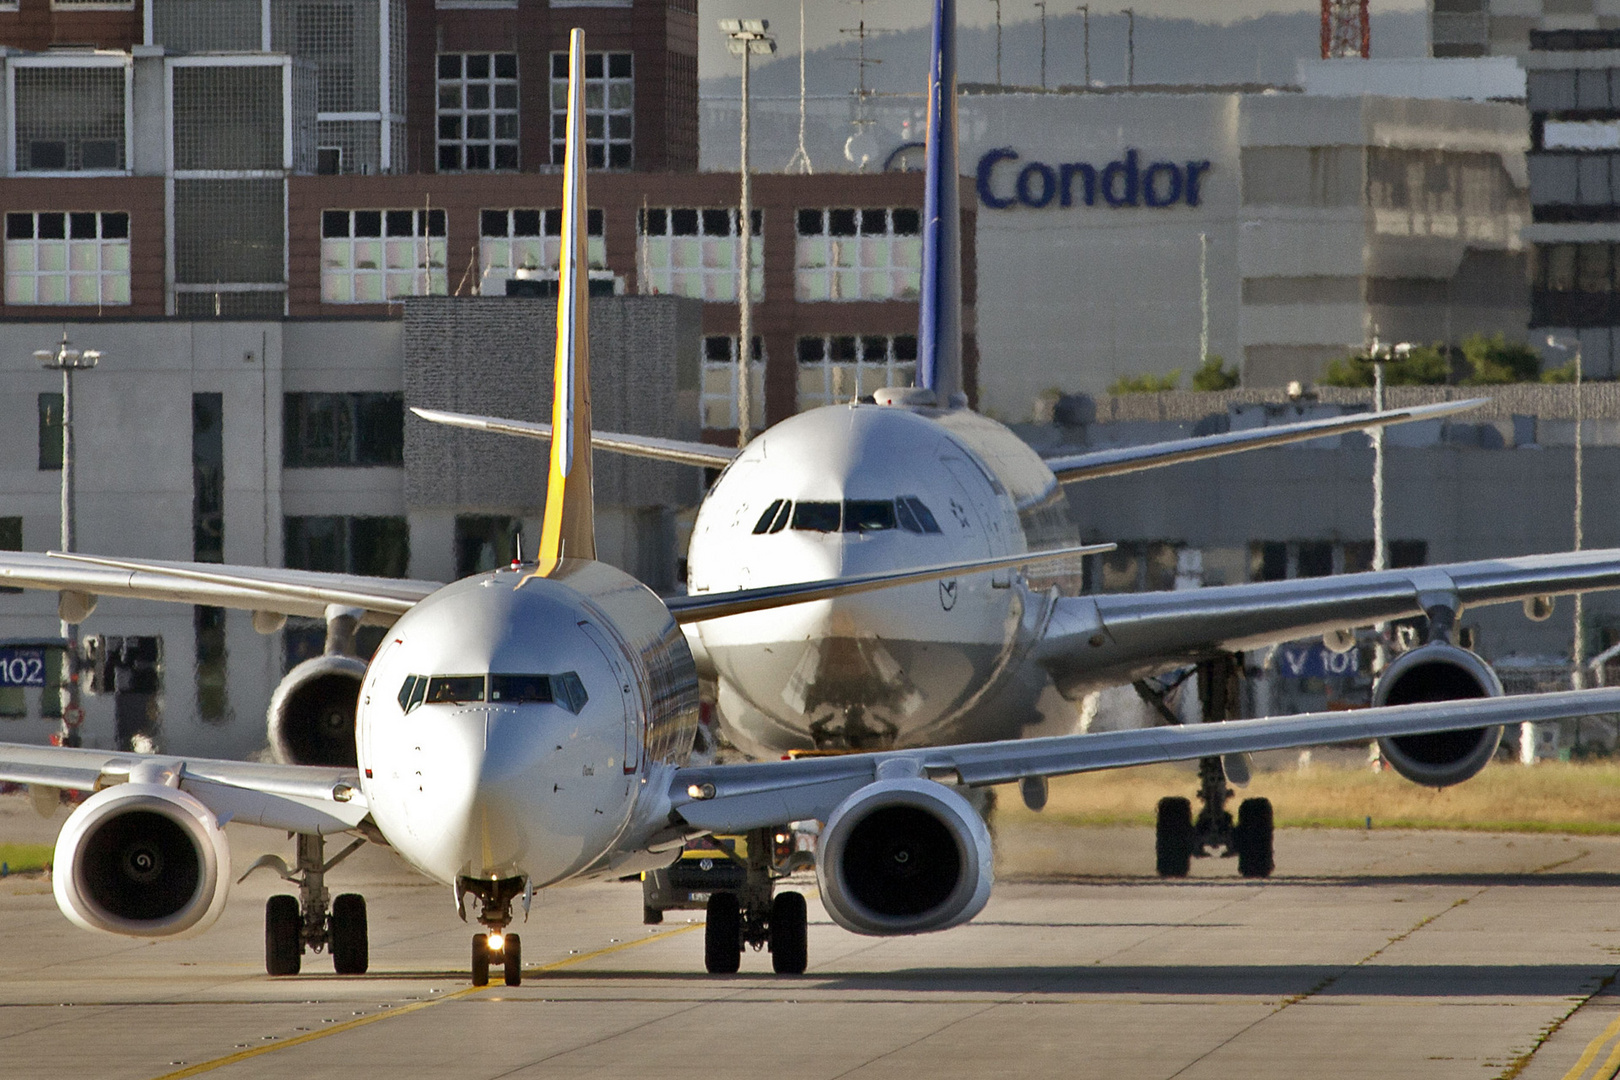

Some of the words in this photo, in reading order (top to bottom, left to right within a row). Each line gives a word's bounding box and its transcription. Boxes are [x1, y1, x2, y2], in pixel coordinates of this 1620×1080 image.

[976, 147, 1210, 209] Condor
[0, 658, 43, 683] 102
[1285, 650, 1308, 675] V
[1320, 648, 1359, 674] 101
